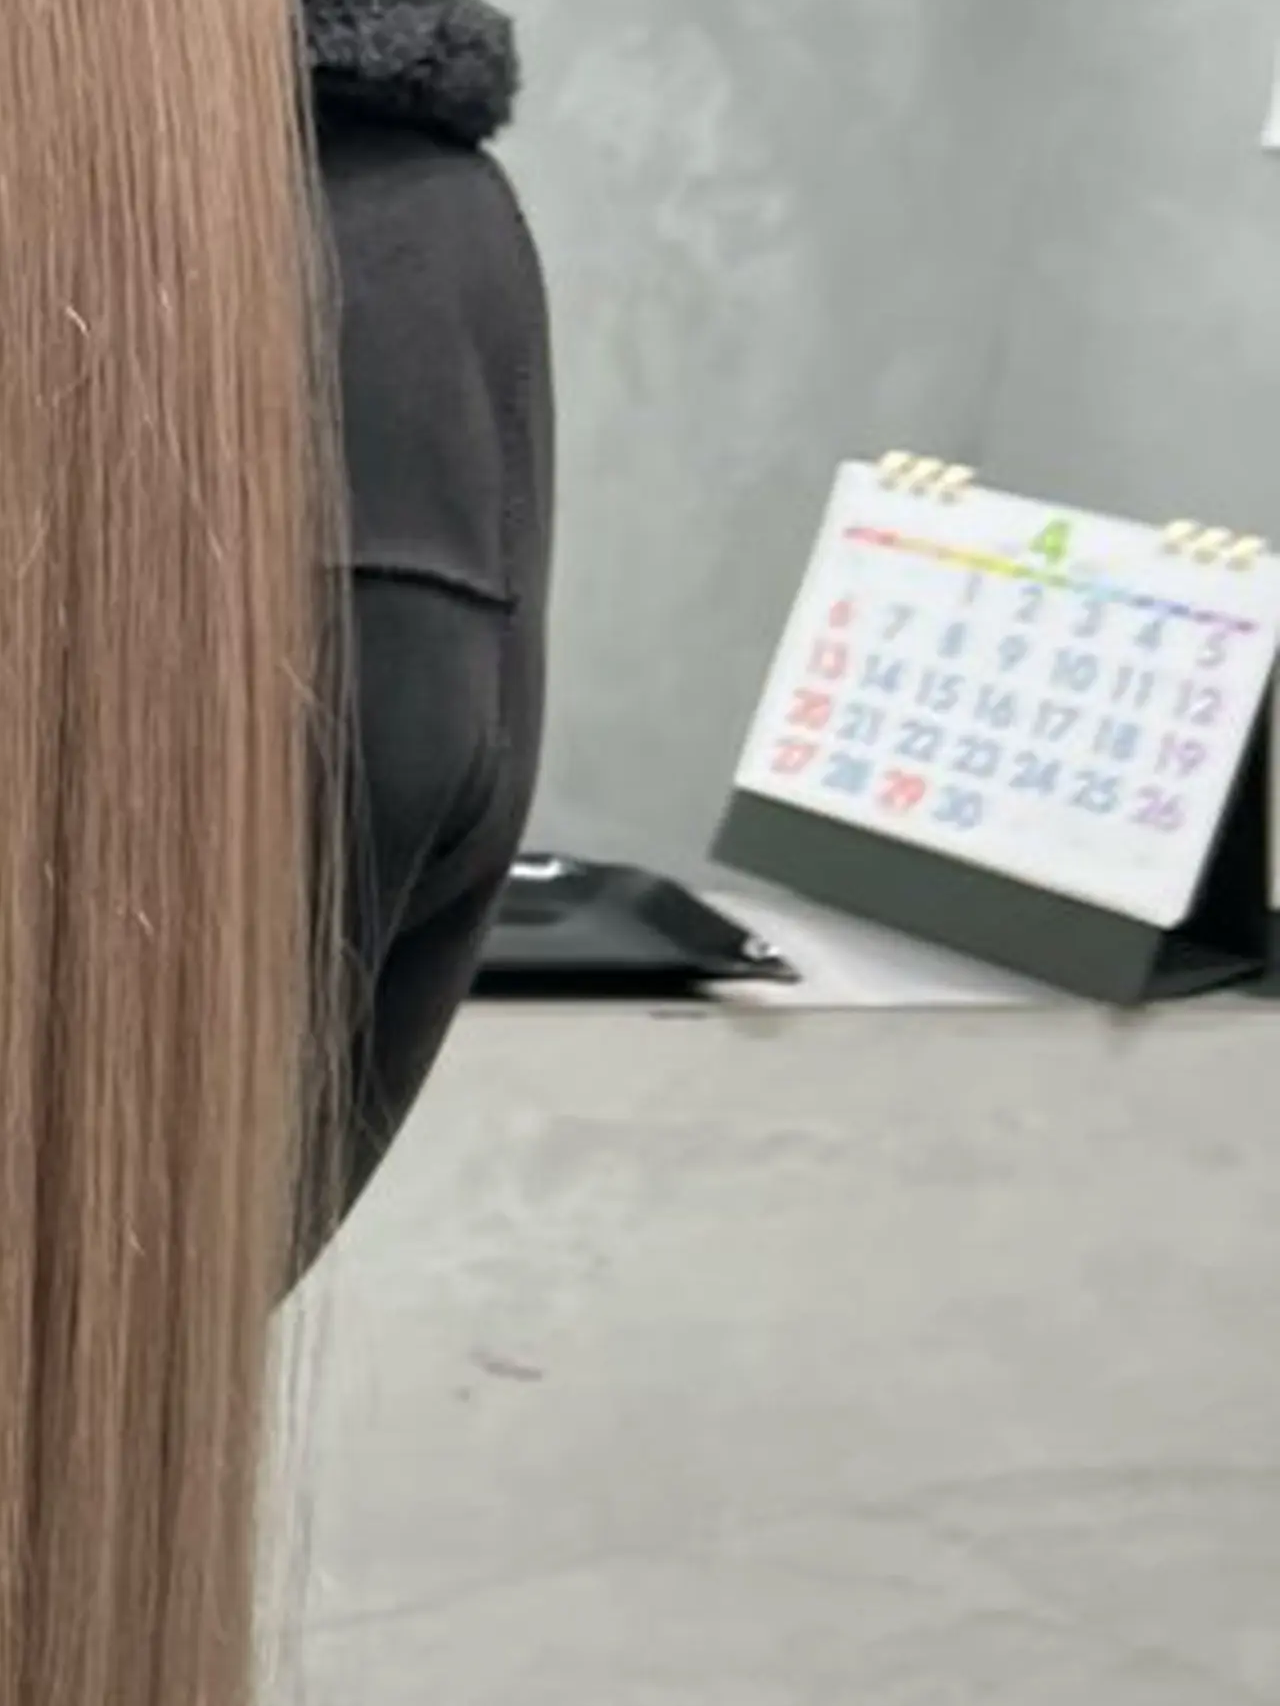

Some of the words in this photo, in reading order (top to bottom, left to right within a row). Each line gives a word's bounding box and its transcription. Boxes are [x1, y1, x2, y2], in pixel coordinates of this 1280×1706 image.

[882, 602, 916, 639] 7
[1112, 664, 1156, 709] 11
[1173, 679, 1222, 726] 12
[915, 669, 966, 714] 15
[973, 684, 1017, 729] 16
[1031, 699, 1080, 742] 17
[1154, 730, 1207, 778] 19
